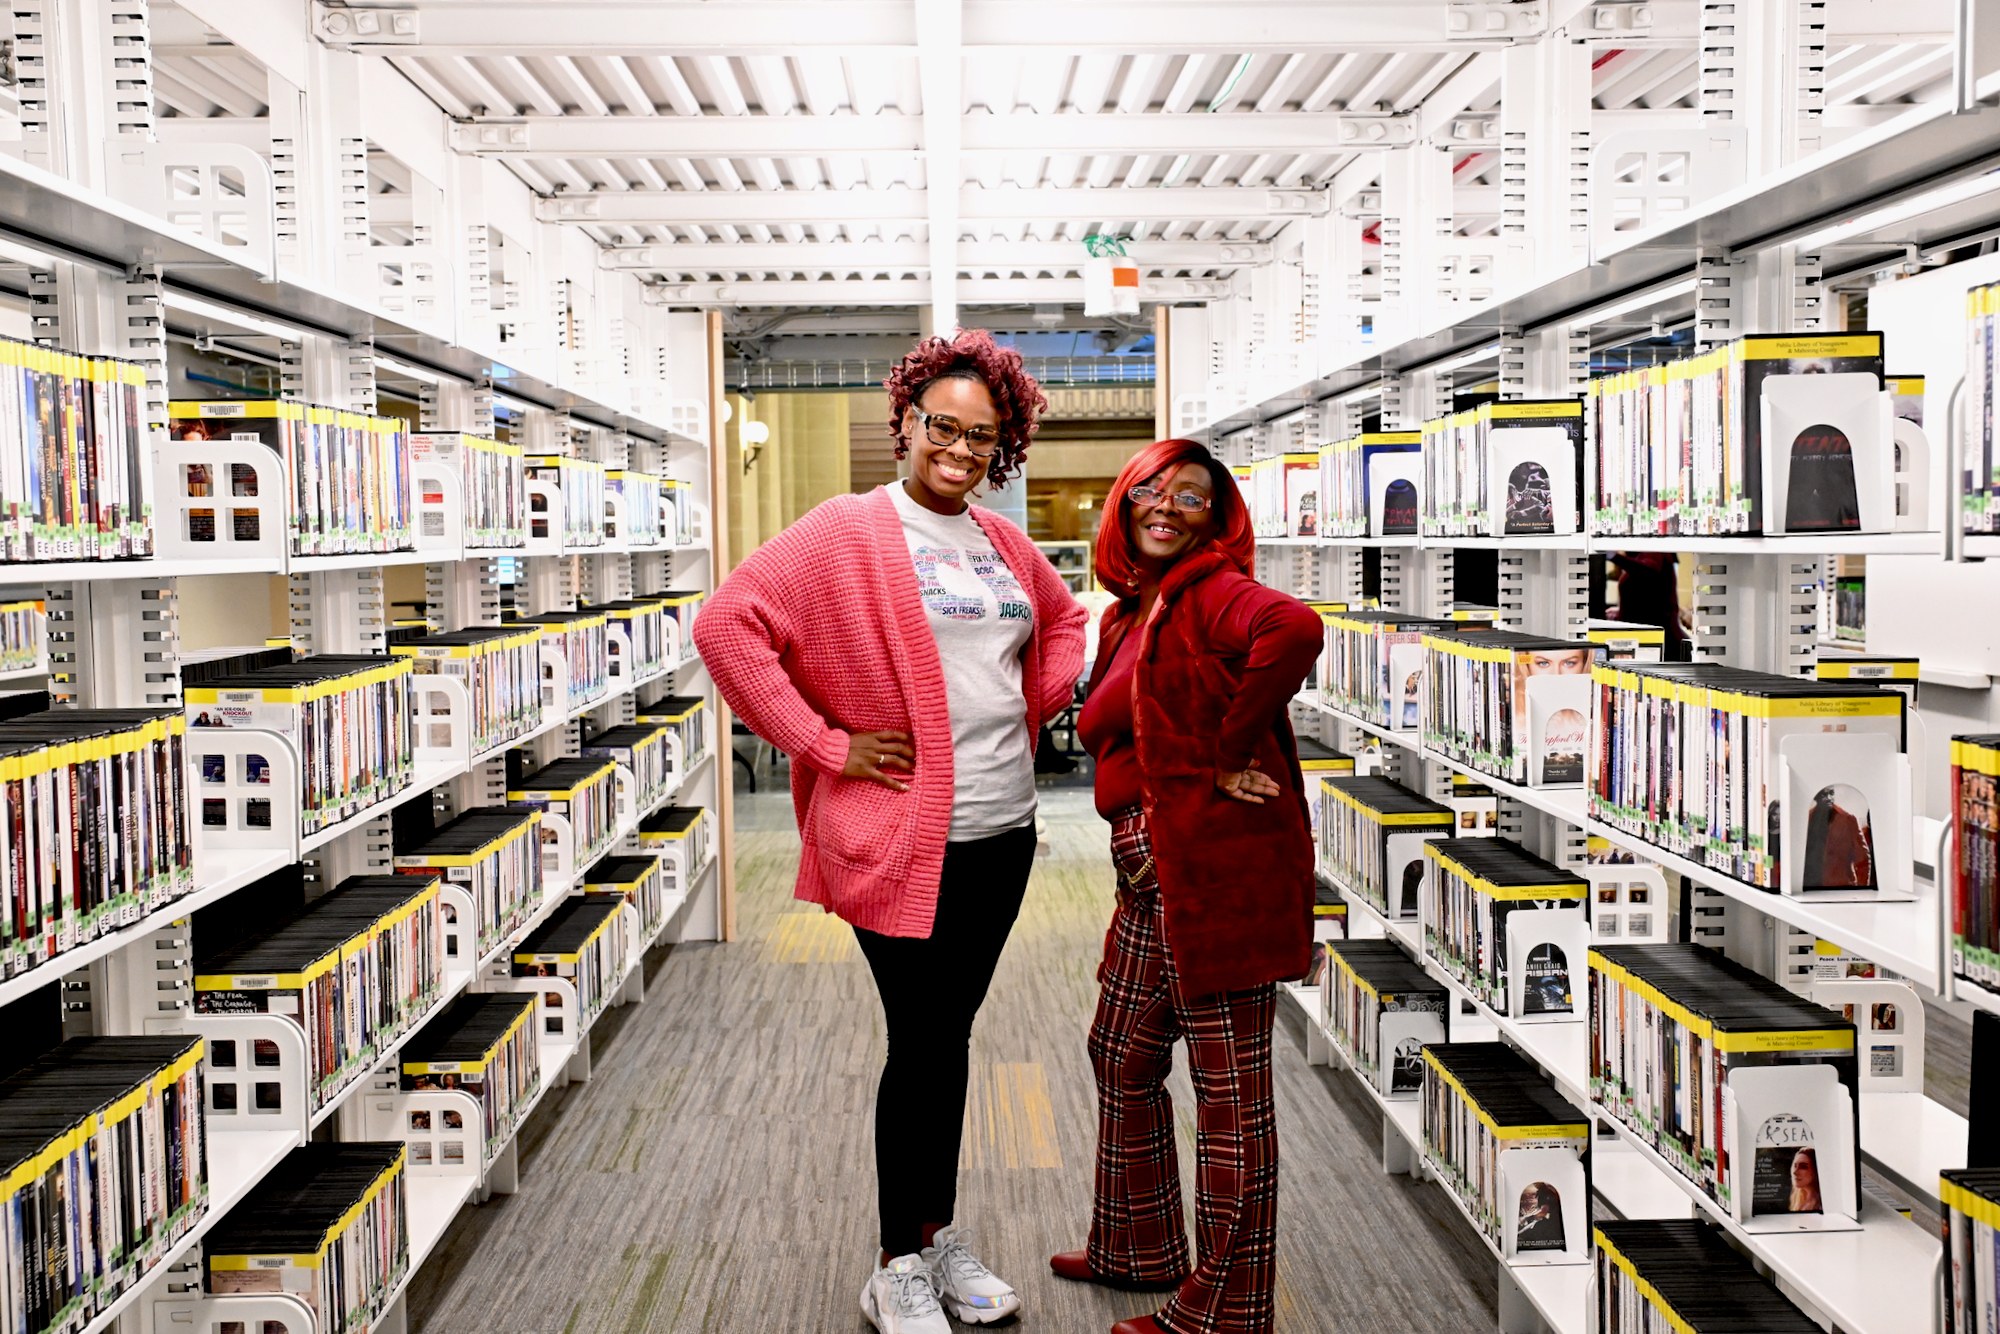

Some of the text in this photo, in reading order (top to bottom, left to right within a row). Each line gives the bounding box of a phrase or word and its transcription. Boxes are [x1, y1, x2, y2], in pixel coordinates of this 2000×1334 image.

[974, 566, 995, 575] BOBO
[920, 588, 946, 596] SNACKS
[942, 606, 957, 614] SICK
[1386, 632, 1422, 643] PETER SELL
[10, 848, 18, 896] ENFORCER
